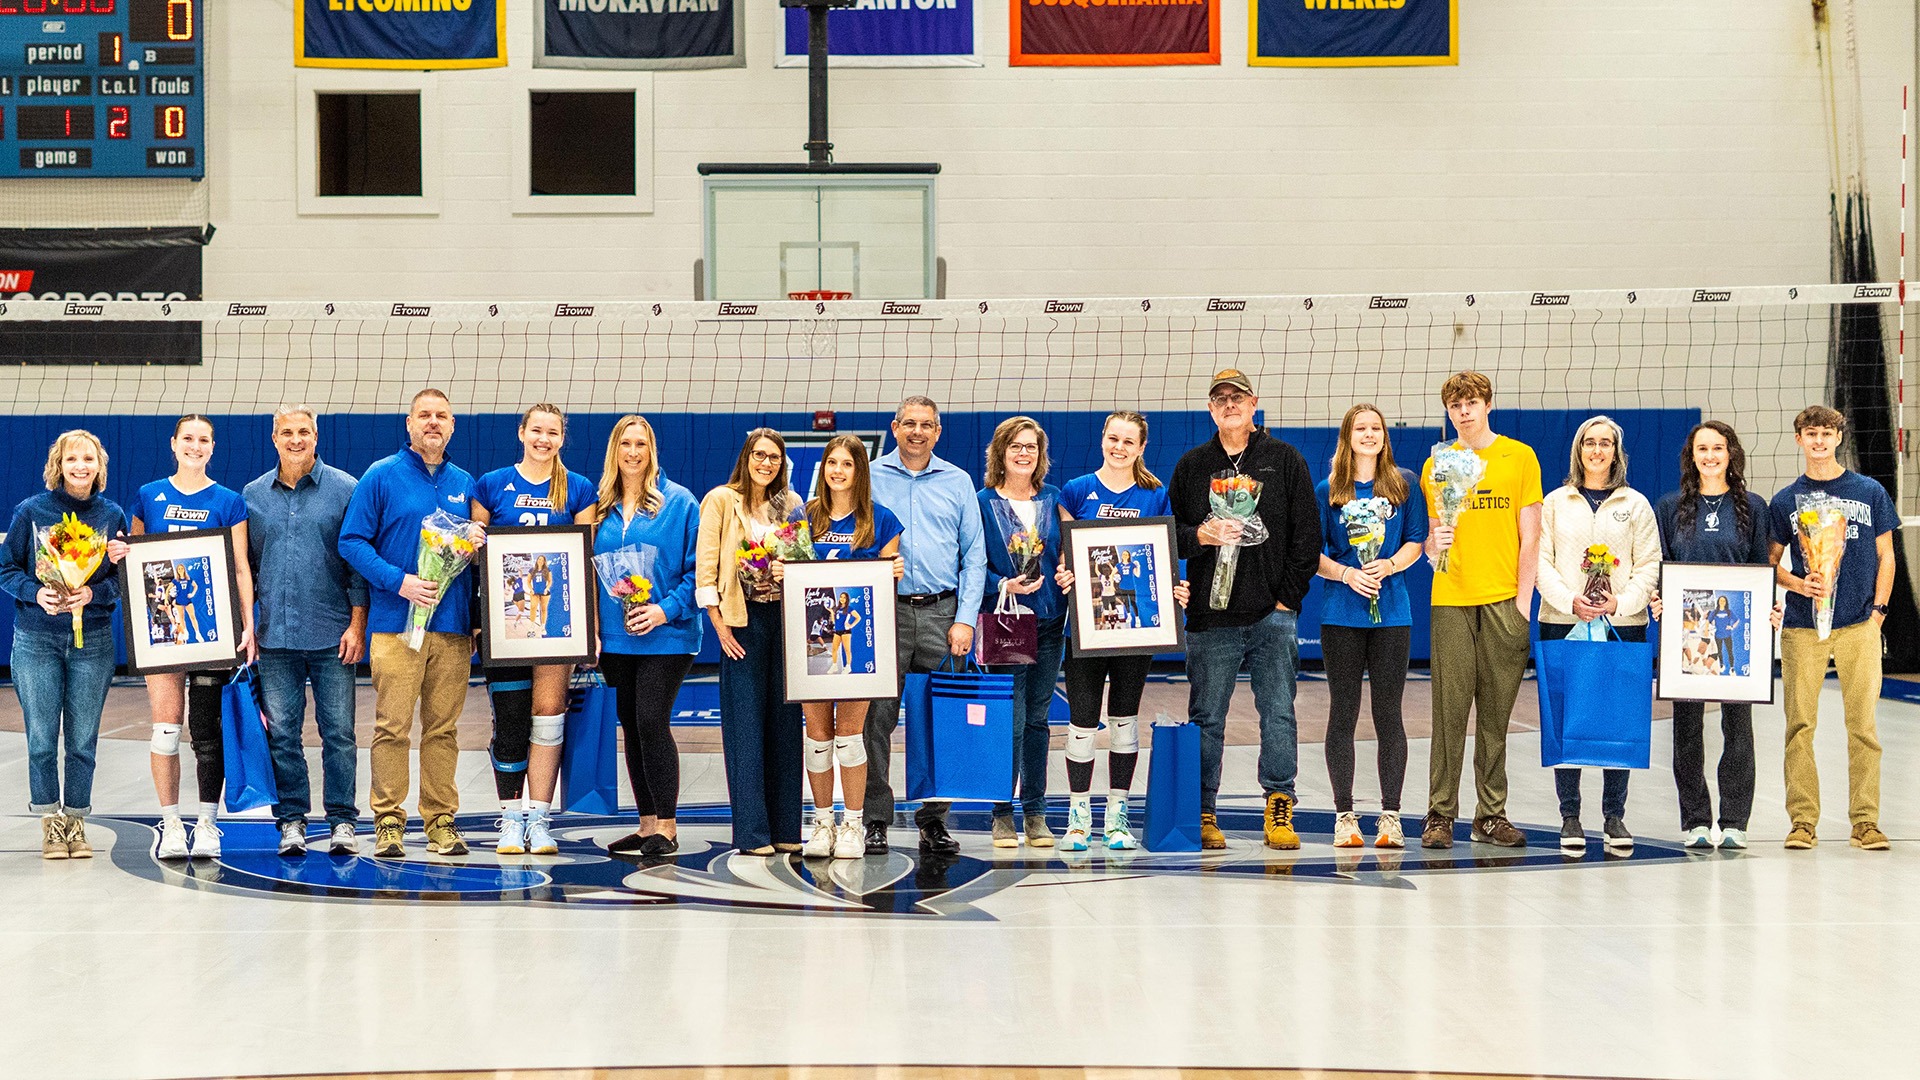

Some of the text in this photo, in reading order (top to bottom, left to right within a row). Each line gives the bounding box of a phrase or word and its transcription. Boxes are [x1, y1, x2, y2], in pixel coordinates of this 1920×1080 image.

[27, 43, 83, 64] period
[27, 75, 81, 96] player
[151, 77, 190, 94] fouls
[110, 106, 129, 137] 2
[164, 106, 184, 137] 0
[35, 150, 77, 168] game
[155, 150, 187, 164] won
